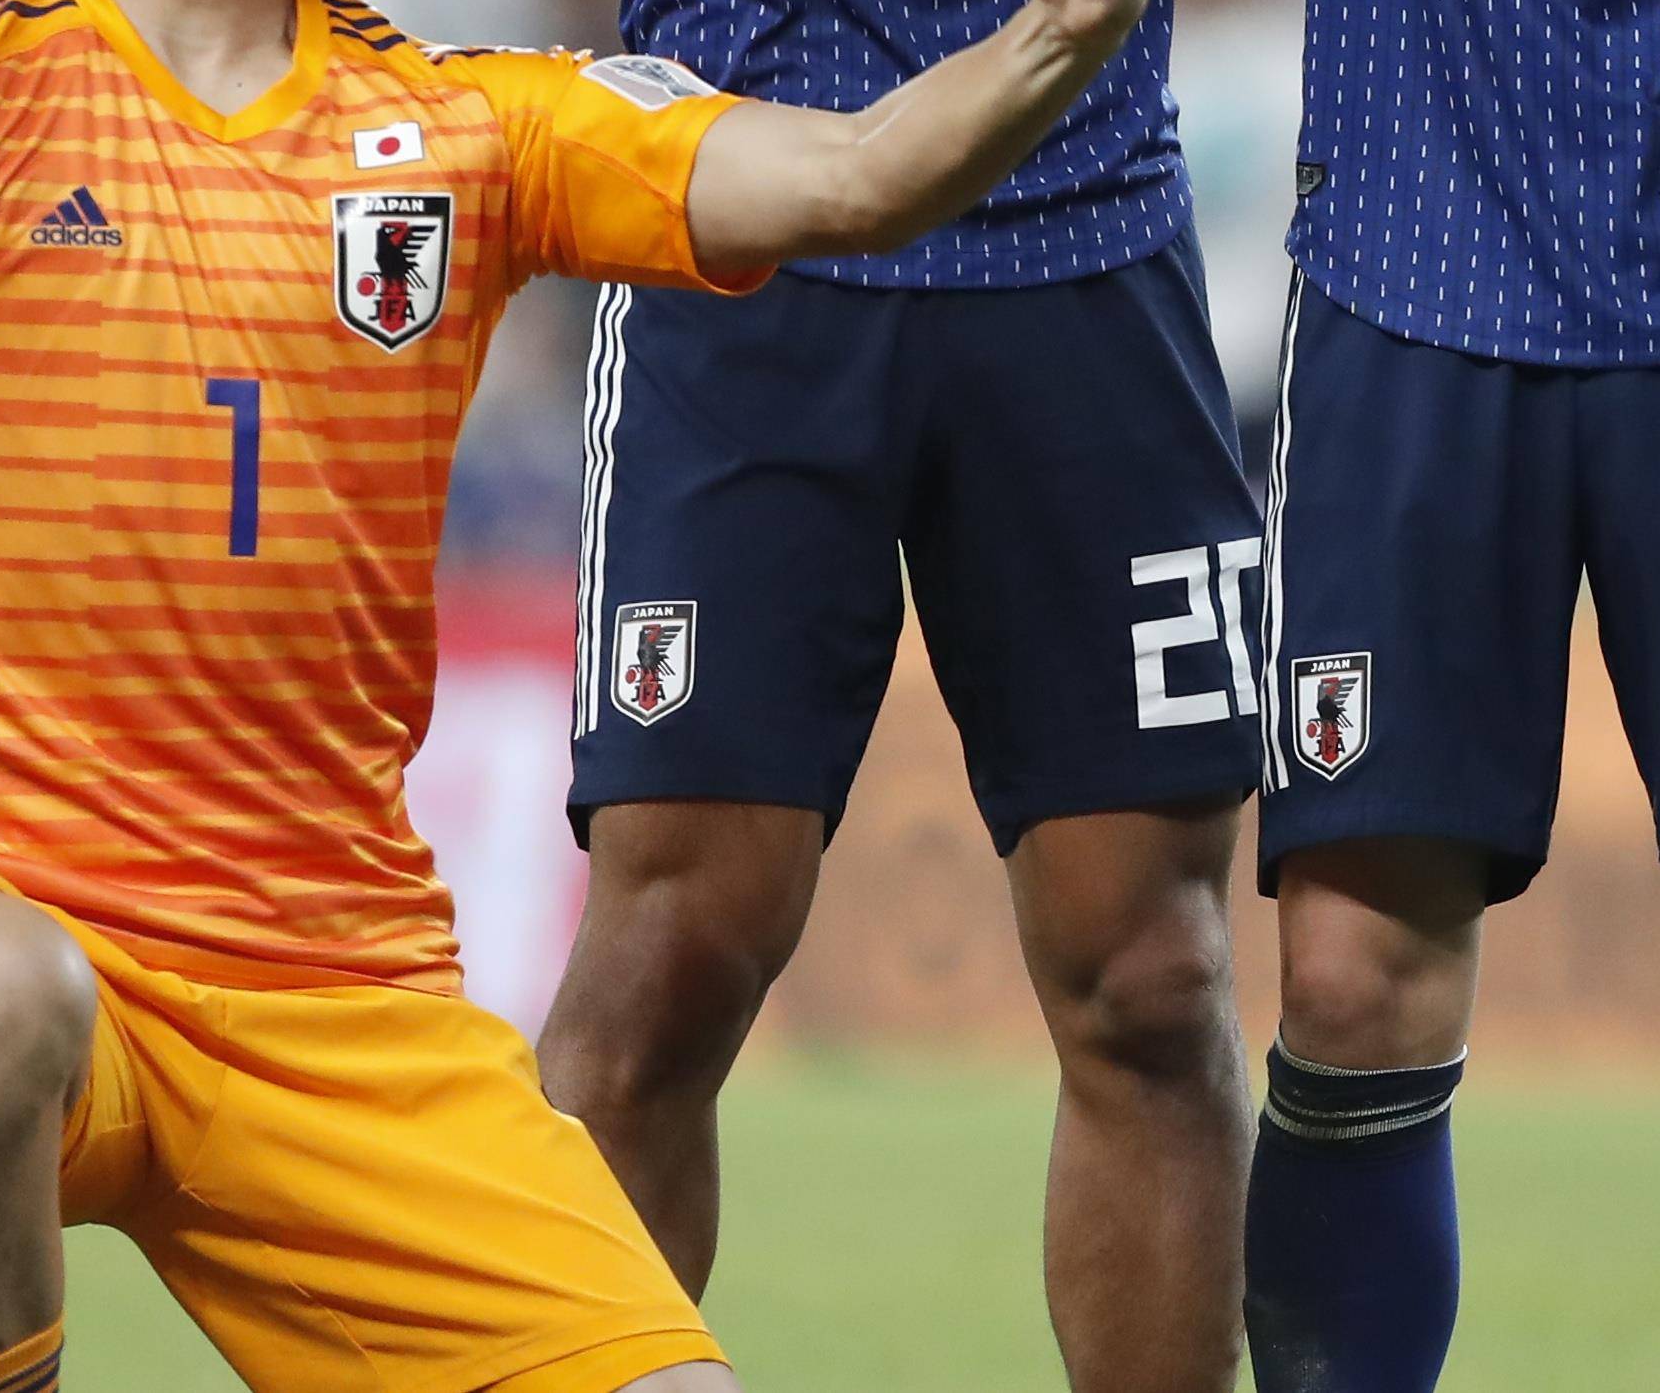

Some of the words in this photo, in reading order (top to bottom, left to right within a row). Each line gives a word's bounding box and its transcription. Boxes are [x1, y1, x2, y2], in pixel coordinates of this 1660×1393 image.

[365, 199, 424, 212] JAPAN
[31, 225, 122, 246] adidas
[206, 378, 259, 556] 1
[632, 606, 674, 618] JAPAN
[1310, 659, 1351, 673] JAPAN
